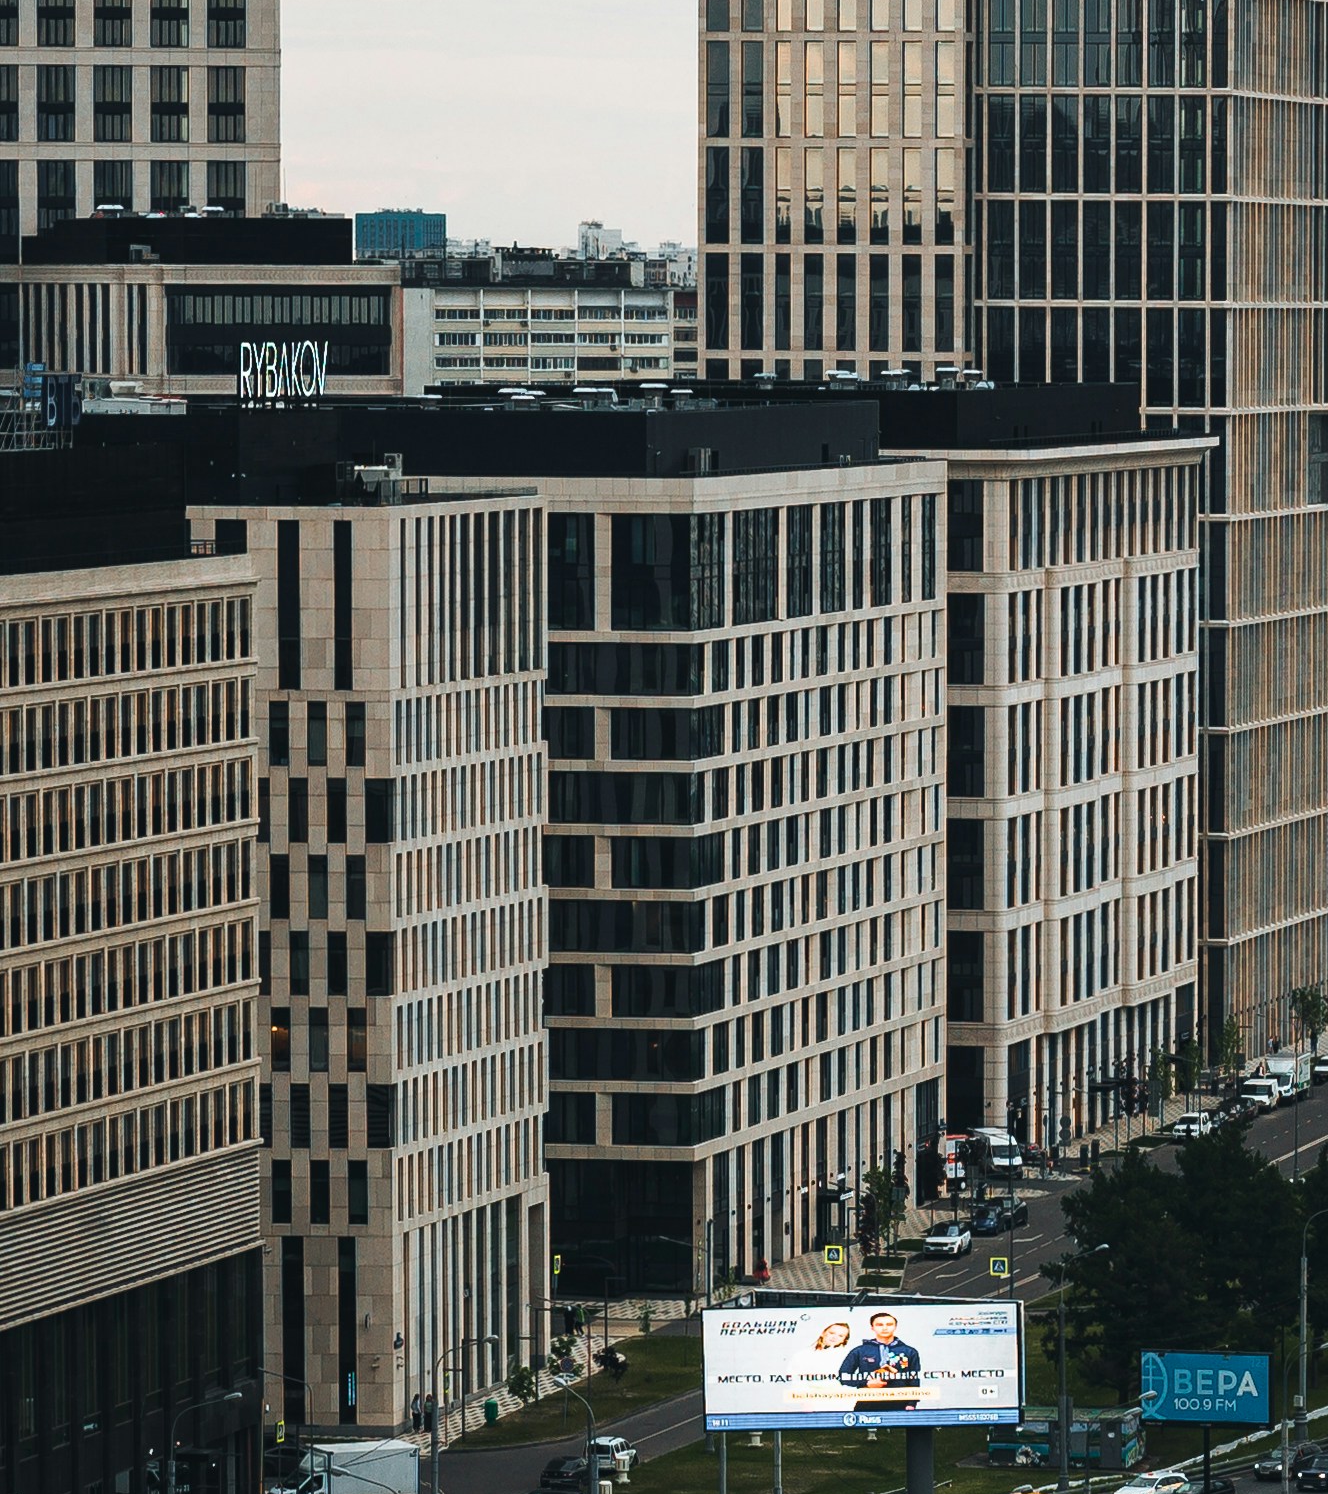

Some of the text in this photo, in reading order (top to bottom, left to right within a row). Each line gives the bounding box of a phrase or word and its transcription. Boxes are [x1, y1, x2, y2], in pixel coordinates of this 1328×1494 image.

[240, 340, 328, 398] RYBAKOV
[717, 1373, 765, 1384] МЕСТО,
[769, 1373, 793, 1384] ГДЕ
[923, 1370, 956, 1379] ЕСТЬ
[961, 1369, 1005, 1379] МЕСТО
[1174, 1369, 1258, 1397] ВЕРА
[1174, 1397, 1236, 1412] 100.9 FM
